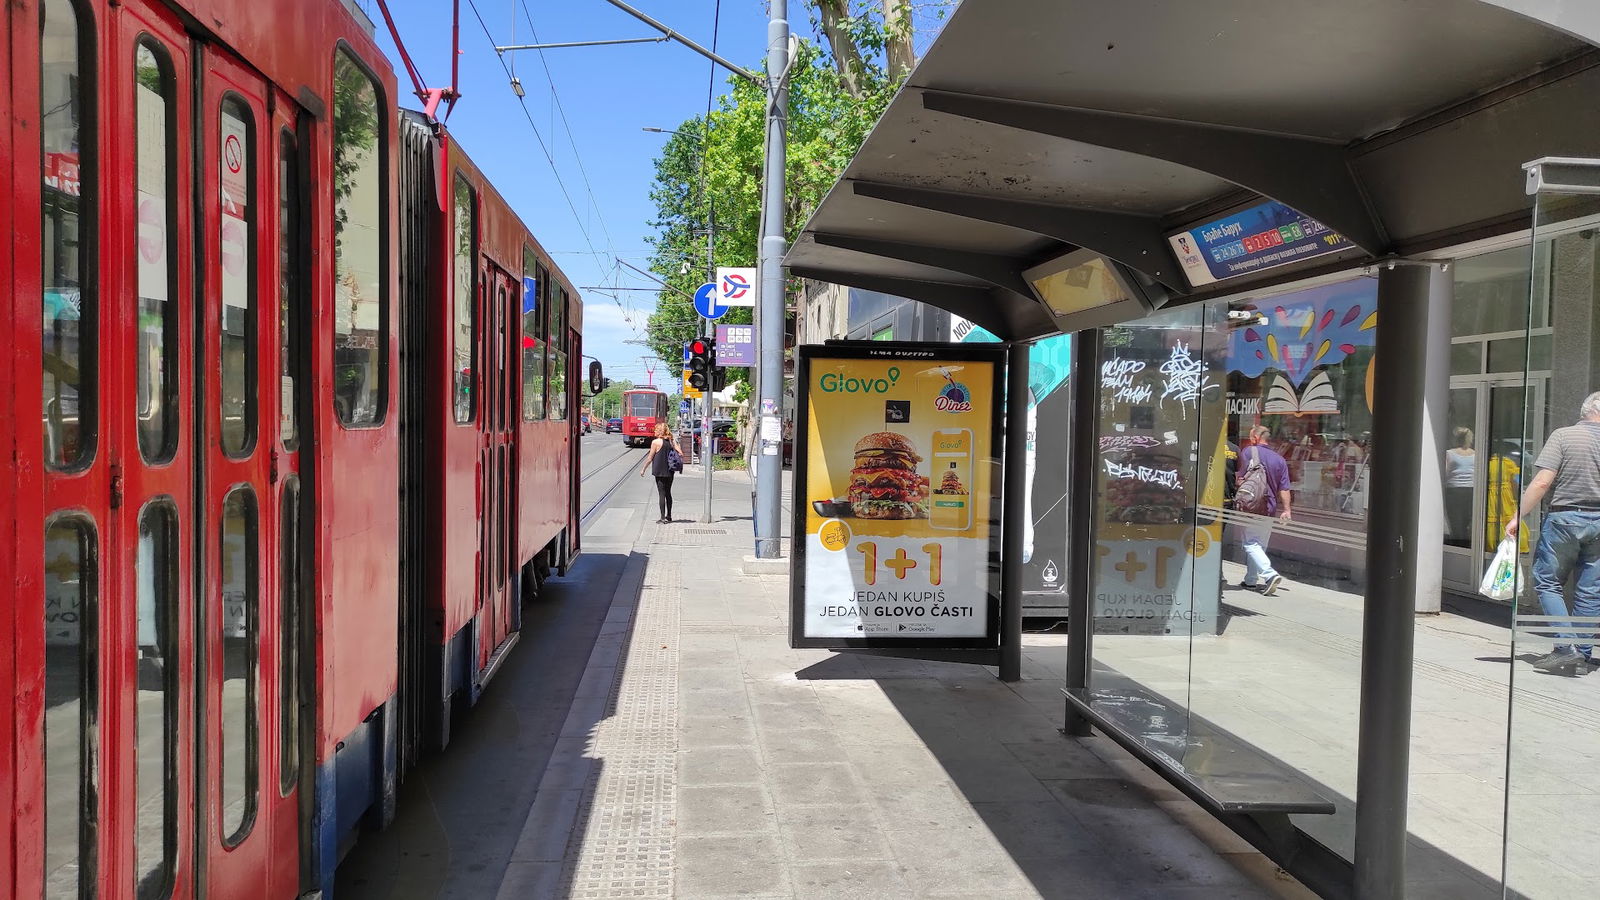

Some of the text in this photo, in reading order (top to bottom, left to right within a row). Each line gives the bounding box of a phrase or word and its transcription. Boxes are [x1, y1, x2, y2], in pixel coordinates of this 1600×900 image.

[1219, 221, 1243, 238] Барух
[1219, 248, 1228, 258] 24
[1227, 245, 1235, 256] 26
[1254, 238, 1261, 248] 2
[1263, 235, 1271, 245] 5
[1272, 232, 1282, 243] 10
[820, 373, 889, 393] Glovo
[934, 396, 973, 412] Diner
[857, 541, 943, 586] 1+1
[849, 589, 945, 603] JEDAN KUPIŠ
[819, 603, 973, 617] JEDAN GLOVO ČASTI
